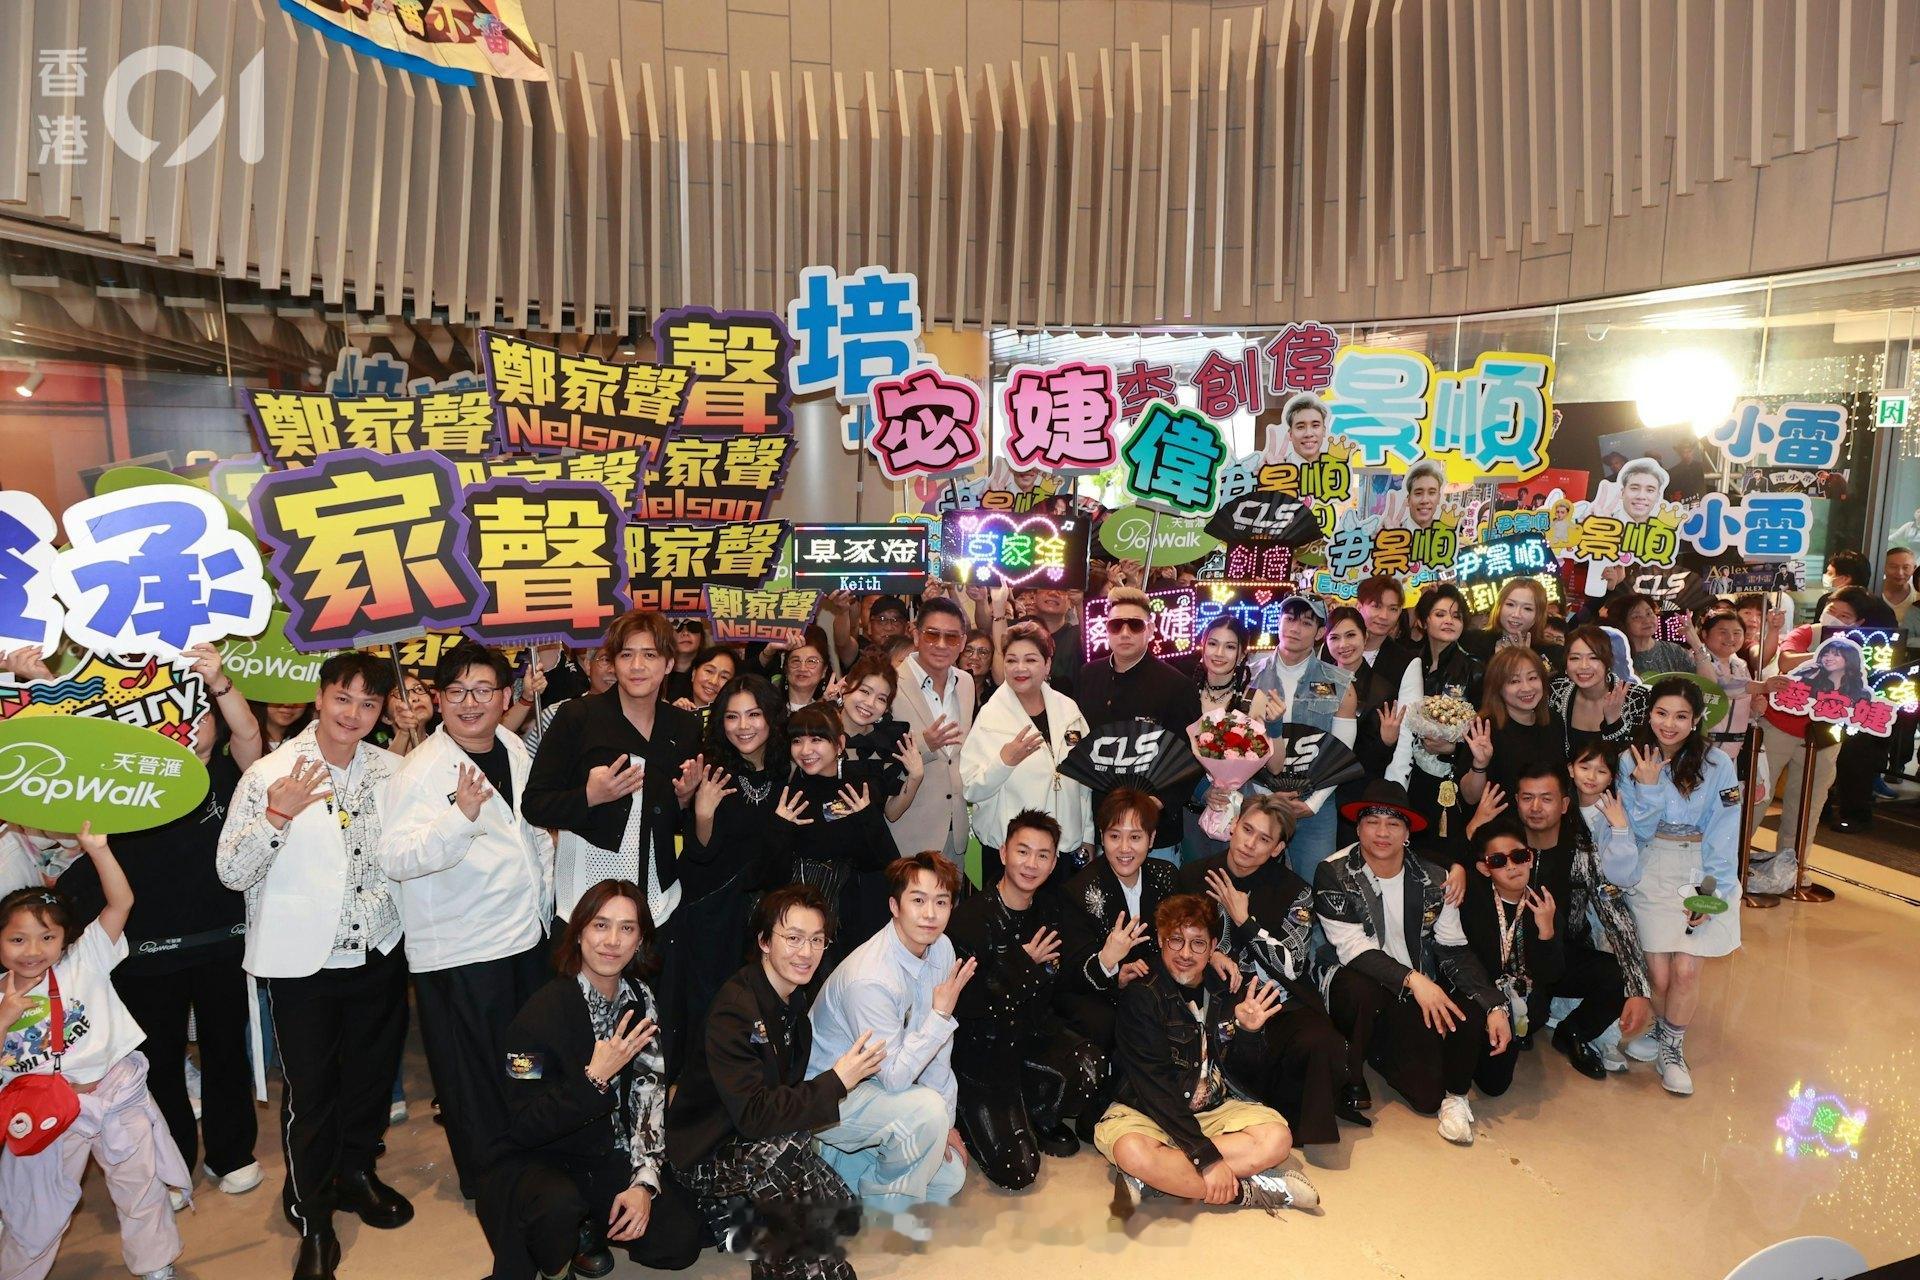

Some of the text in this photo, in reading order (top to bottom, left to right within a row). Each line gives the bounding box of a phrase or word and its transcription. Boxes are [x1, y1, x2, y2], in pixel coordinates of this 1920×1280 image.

[797, 274, 913, 395] 培
[1267, 325, 1338, 392] 偉
[489, 337, 695, 426] 鄭家聲
[669, 322, 779, 434] 聲
[1193, 349, 1262, 419] 創
[254, 392, 494, 458] 鄭家聲
[506, 406, 662, 463] Nelson
[1013, 369, 1109, 461] 婕
[1330, 354, 1544, 471] 景順
[1714, 405, 1841, 465] 小雷
[646, 437, 786, 490] 家聲
[1128, 410, 1220, 505] 偉
[274, 470, 466, 633] 家
[1329, 520, 1458, 577] 尹景順
[1577, 516, 1676, 566] 景順
[1683, 498, 1806, 554] 小雷
[71, 501, 253, 650] 承
[474, 497, 614, 629] 聲
[840, 576, 881, 590] Keith
[1456, 538, 1547, 581] 尹景順
[1633, 571, 1691, 595] CLS
[708, 586, 818, 622] 鄭家聲
[76, 680, 197, 727] ary
[0, 741, 166, 809] PopWalk
[1089, 729, 1166, 766] CLS
